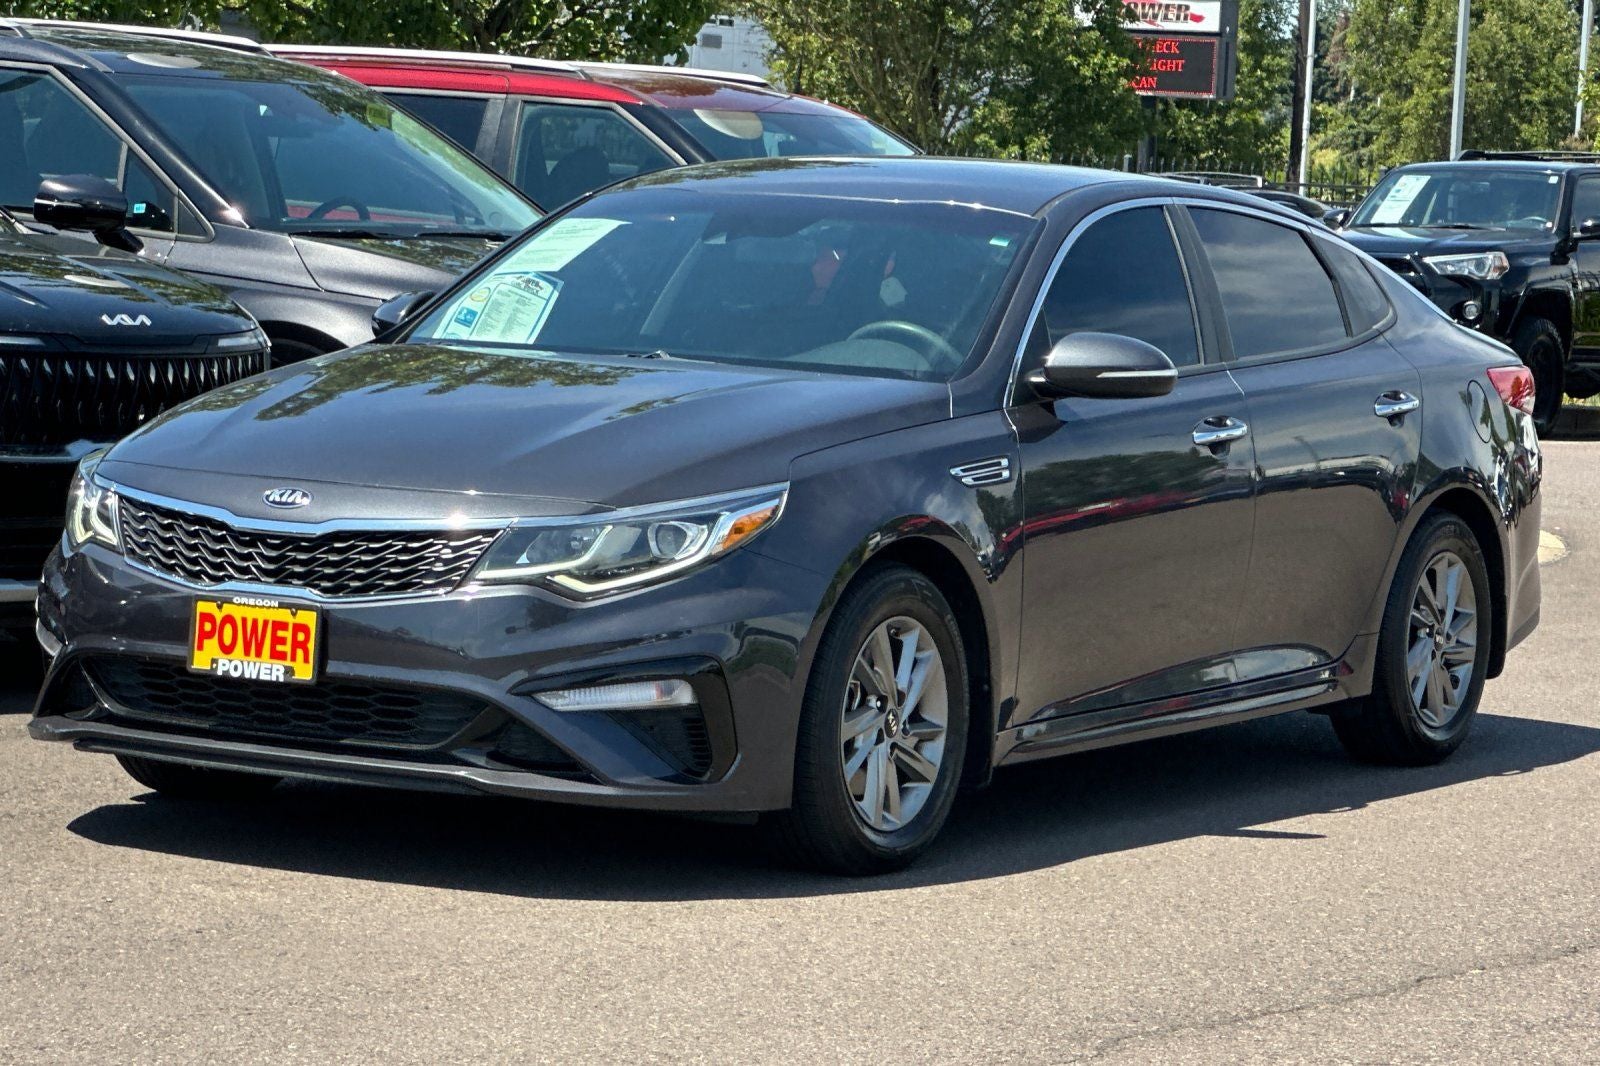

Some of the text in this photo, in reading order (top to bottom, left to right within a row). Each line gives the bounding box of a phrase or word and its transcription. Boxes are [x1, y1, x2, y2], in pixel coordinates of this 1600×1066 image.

[1123, 2, 1190, 23] OWER
[1149, 59, 1185, 72] IGHT
[268, 489, 303, 504] KIA
[233, 596, 279, 608] OREGON
[196, 611, 311, 664] POWER
[217, 658, 285, 682] POWER
